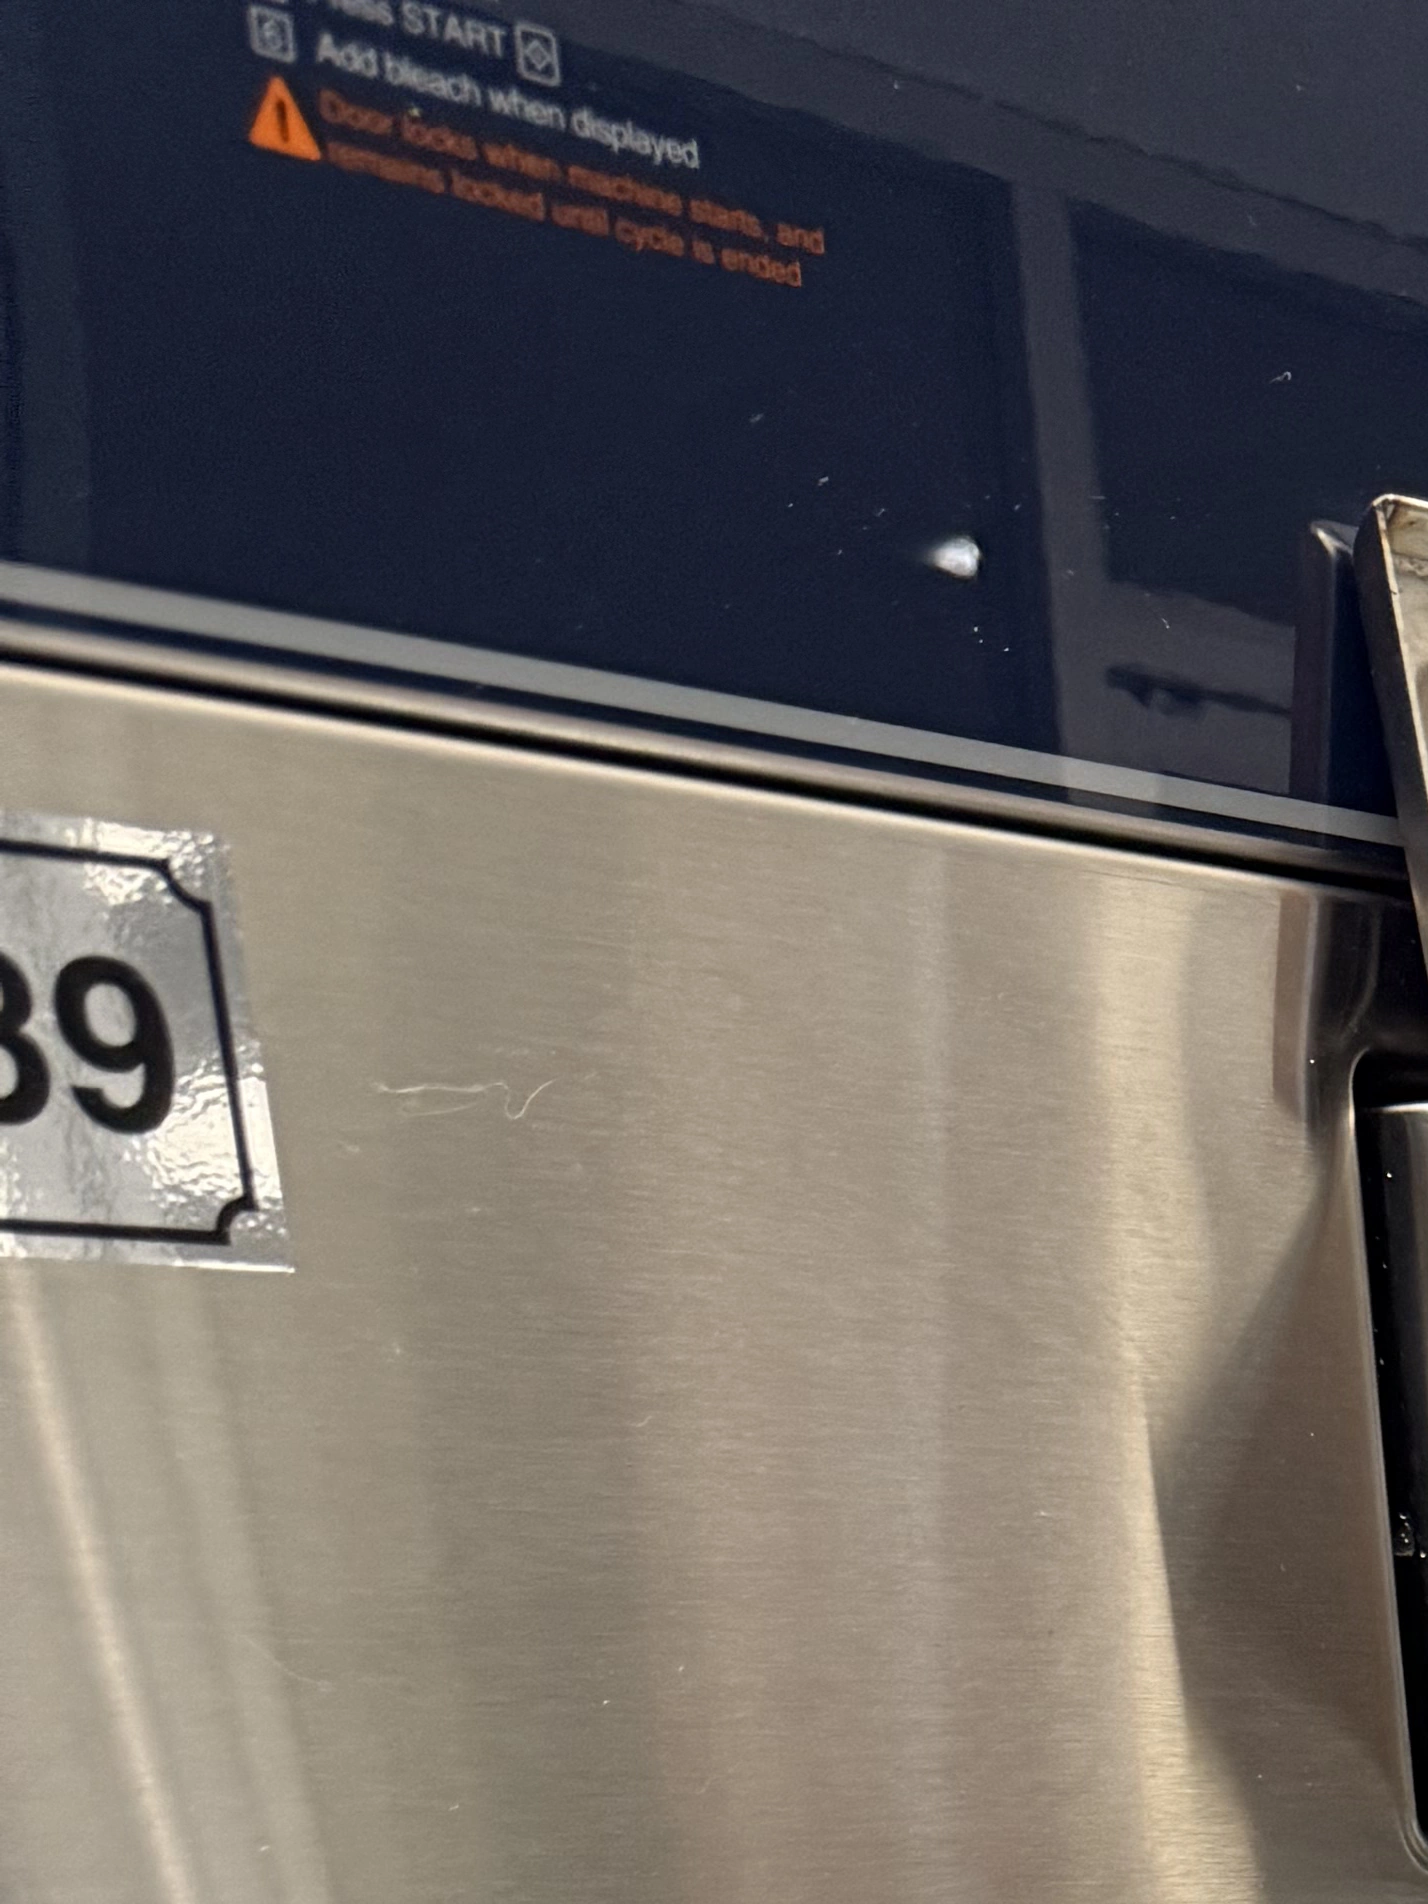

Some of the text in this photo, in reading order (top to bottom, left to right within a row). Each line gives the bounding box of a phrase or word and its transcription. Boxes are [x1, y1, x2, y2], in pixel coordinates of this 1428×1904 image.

[402, 1, 506, 58] START
[317, 32, 378, 79] Add
[384, 50, 482, 106] bleach
[488, 86, 566, 132] when
[570, 106, 699, 169] displayed
[615, 216, 685, 254] cycle
[692, 238, 715, 265] is
[720, 248, 801, 288] ended
[777, 222, 825, 255] and
